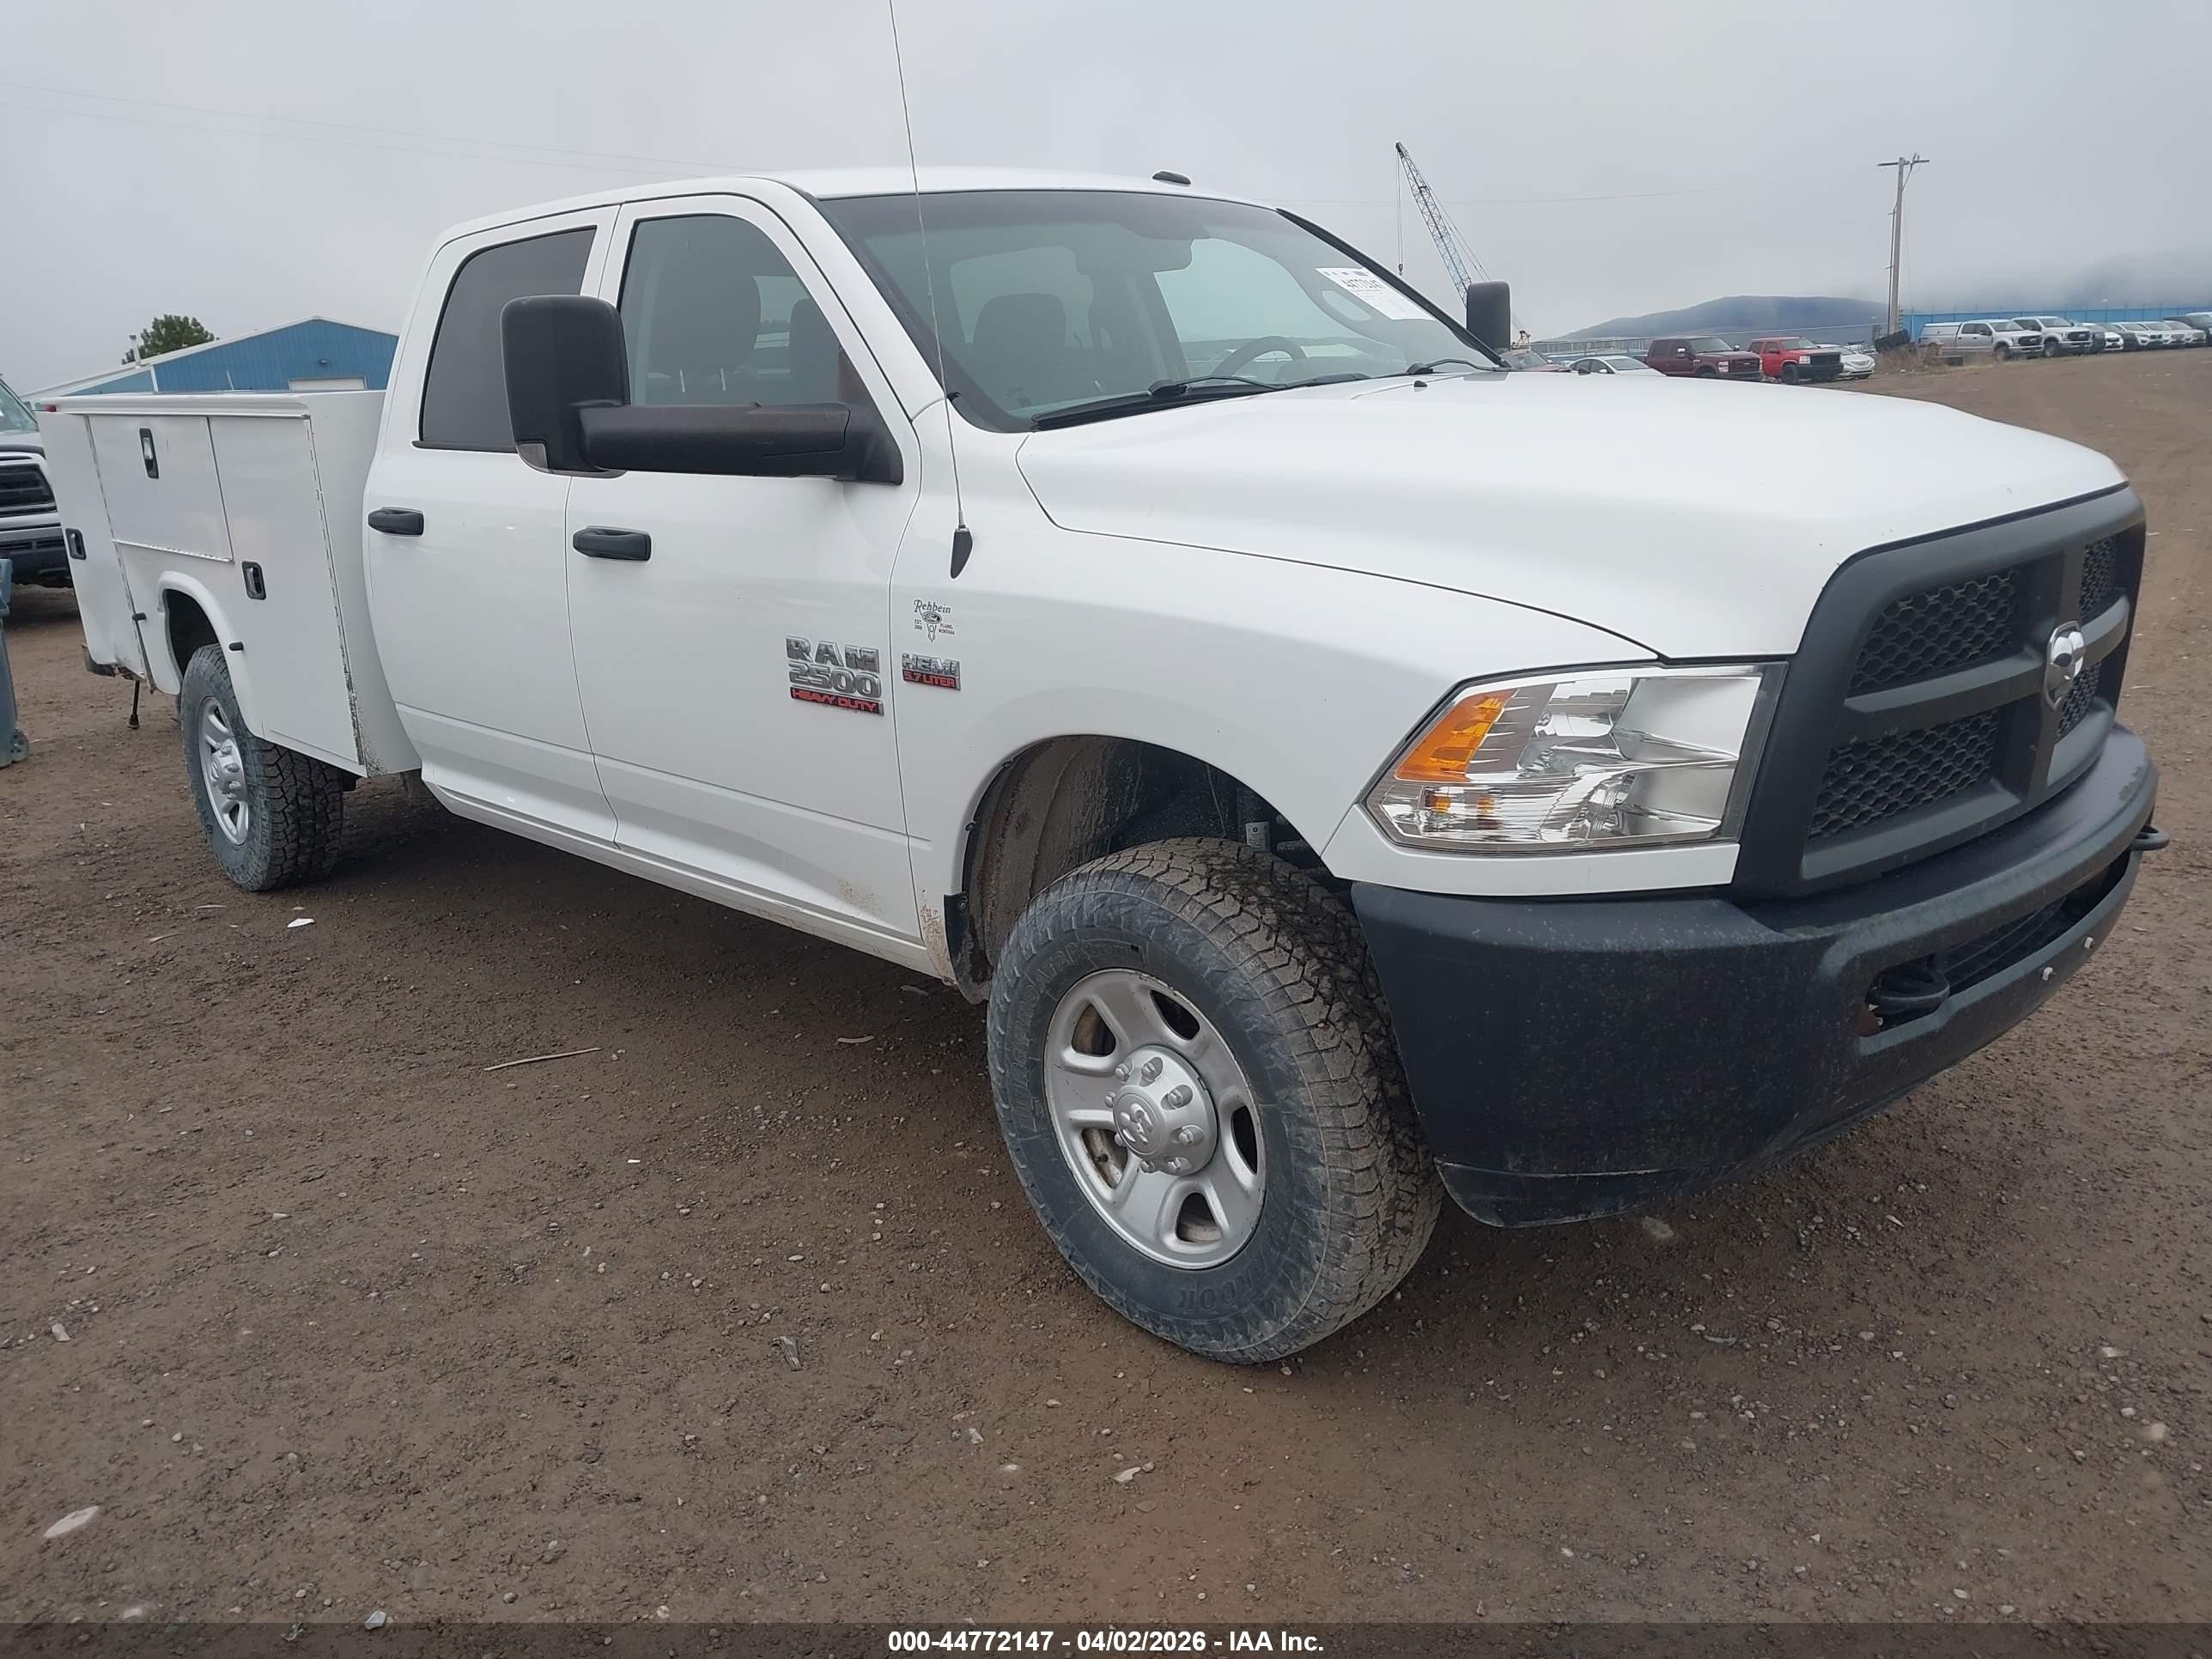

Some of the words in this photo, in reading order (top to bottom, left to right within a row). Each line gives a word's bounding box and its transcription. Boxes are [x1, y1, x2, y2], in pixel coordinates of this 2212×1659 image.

[913, 599, 951, 615] Rehbein
[786, 635, 879, 673] RAM
[902, 653, 958, 677] HEMI
[788, 660, 882, 698] 2500
[903, 671, 921, 684] 5.7
[922, 673, 957, 688] LITER
[793, 689, 836, 704] HEAVY
[837, 696, 878, 712] DUTY
